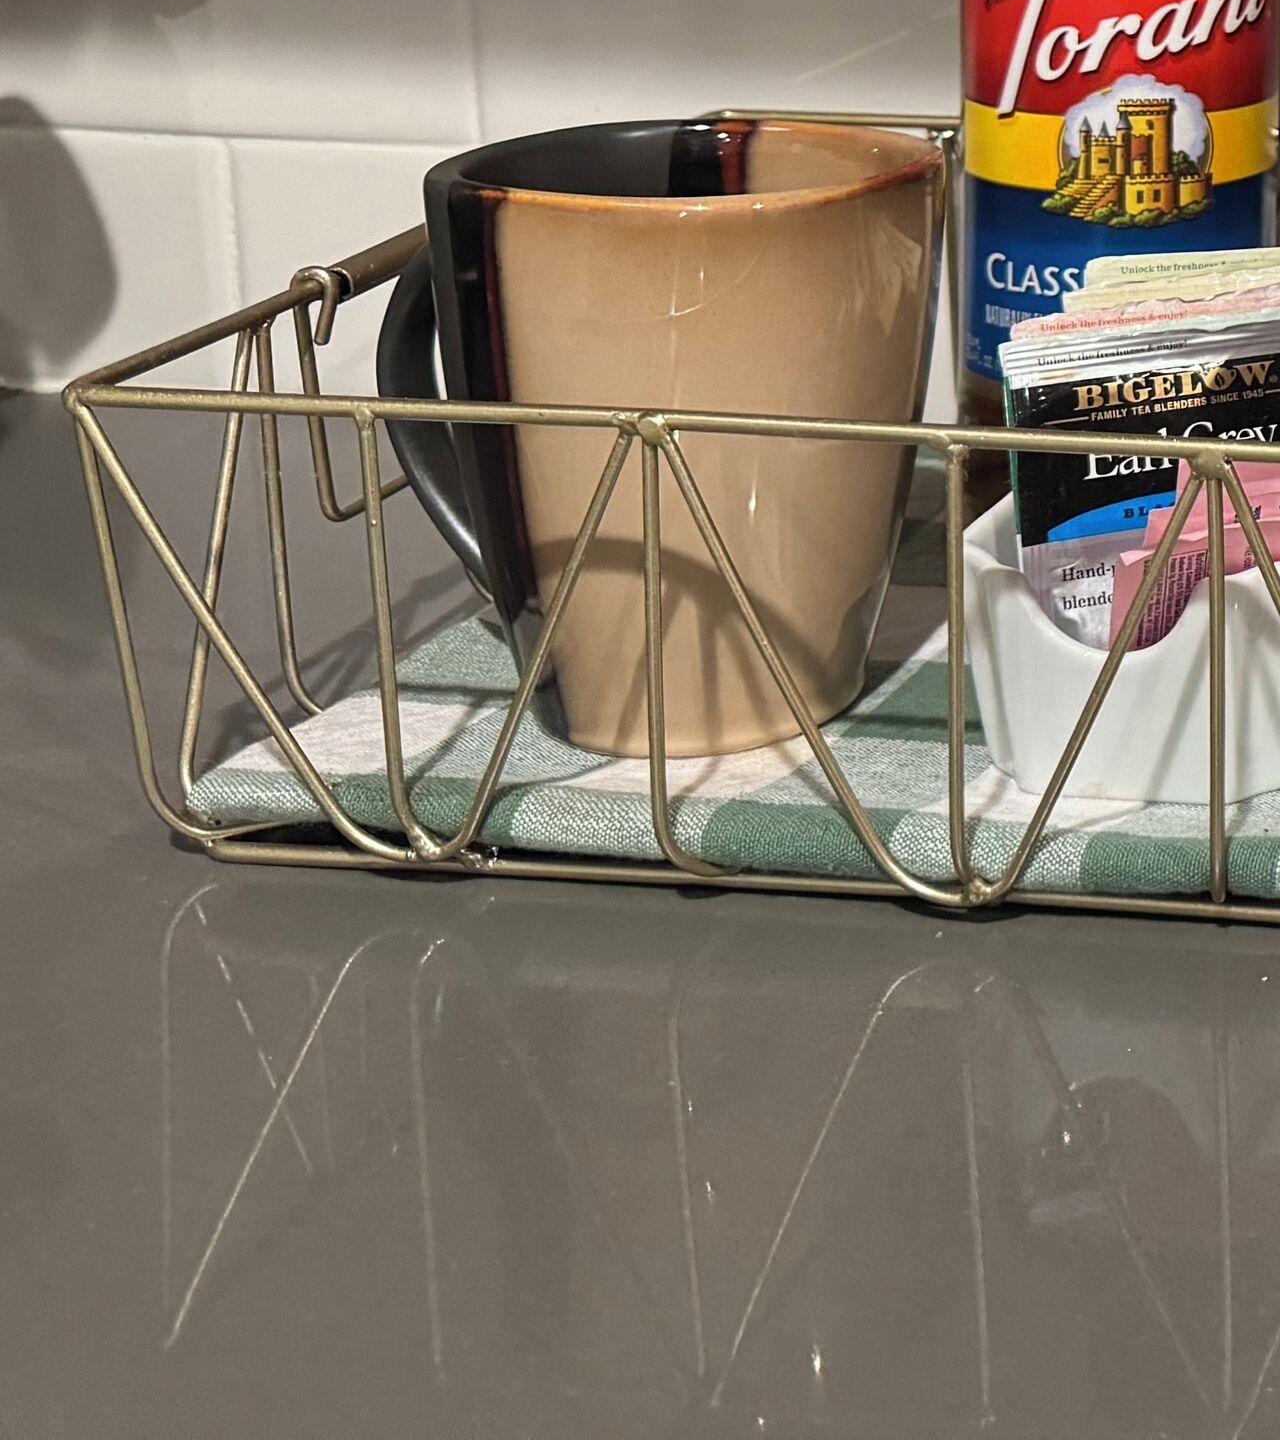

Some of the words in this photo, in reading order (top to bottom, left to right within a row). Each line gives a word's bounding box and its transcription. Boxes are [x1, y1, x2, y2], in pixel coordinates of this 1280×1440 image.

[1120, 264, 1156, 275] Unlock
[1157, 263, 1172, 273] the
[1040, 321, 1077, 333] Unlock
[1079, 319, 1096, 329] the
[1072, 360, 1274, 411] BIGELOW
[1091, 408, 1128, 422] FAMILY
[1132, 405, 1152, 416] TEA
[1154, 397, 1207, 413] BLENDERS
[1210, 392, 1239, 404] SINCE
[1242, 387, 1264, 401] 1945
